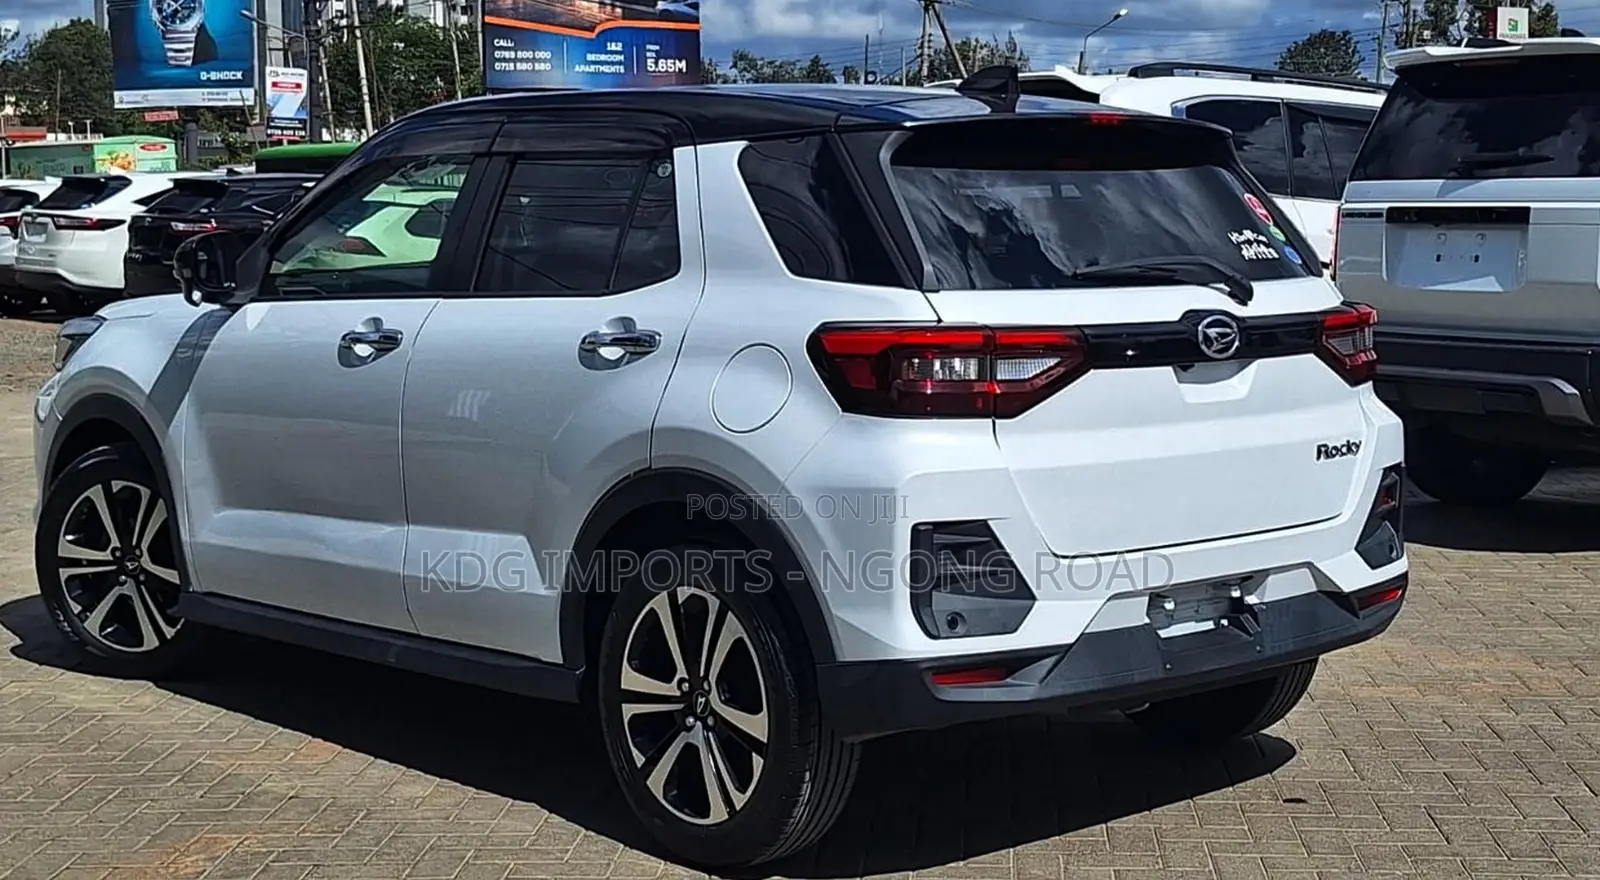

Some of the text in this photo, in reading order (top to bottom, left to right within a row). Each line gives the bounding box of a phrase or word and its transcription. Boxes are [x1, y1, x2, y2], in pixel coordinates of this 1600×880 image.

[494, 38, 515, 47] CALL:
[534, 50, 551, 59] 000
[586, 53, 624, 62] BEDROOM
[574, 64, 625, 73] APARTMENTS
[647, 58, 687, 72] 5.65M
[199, 71, 243, 81] G-SHOCK
[1316, 439, 1362, 461] Rocky
